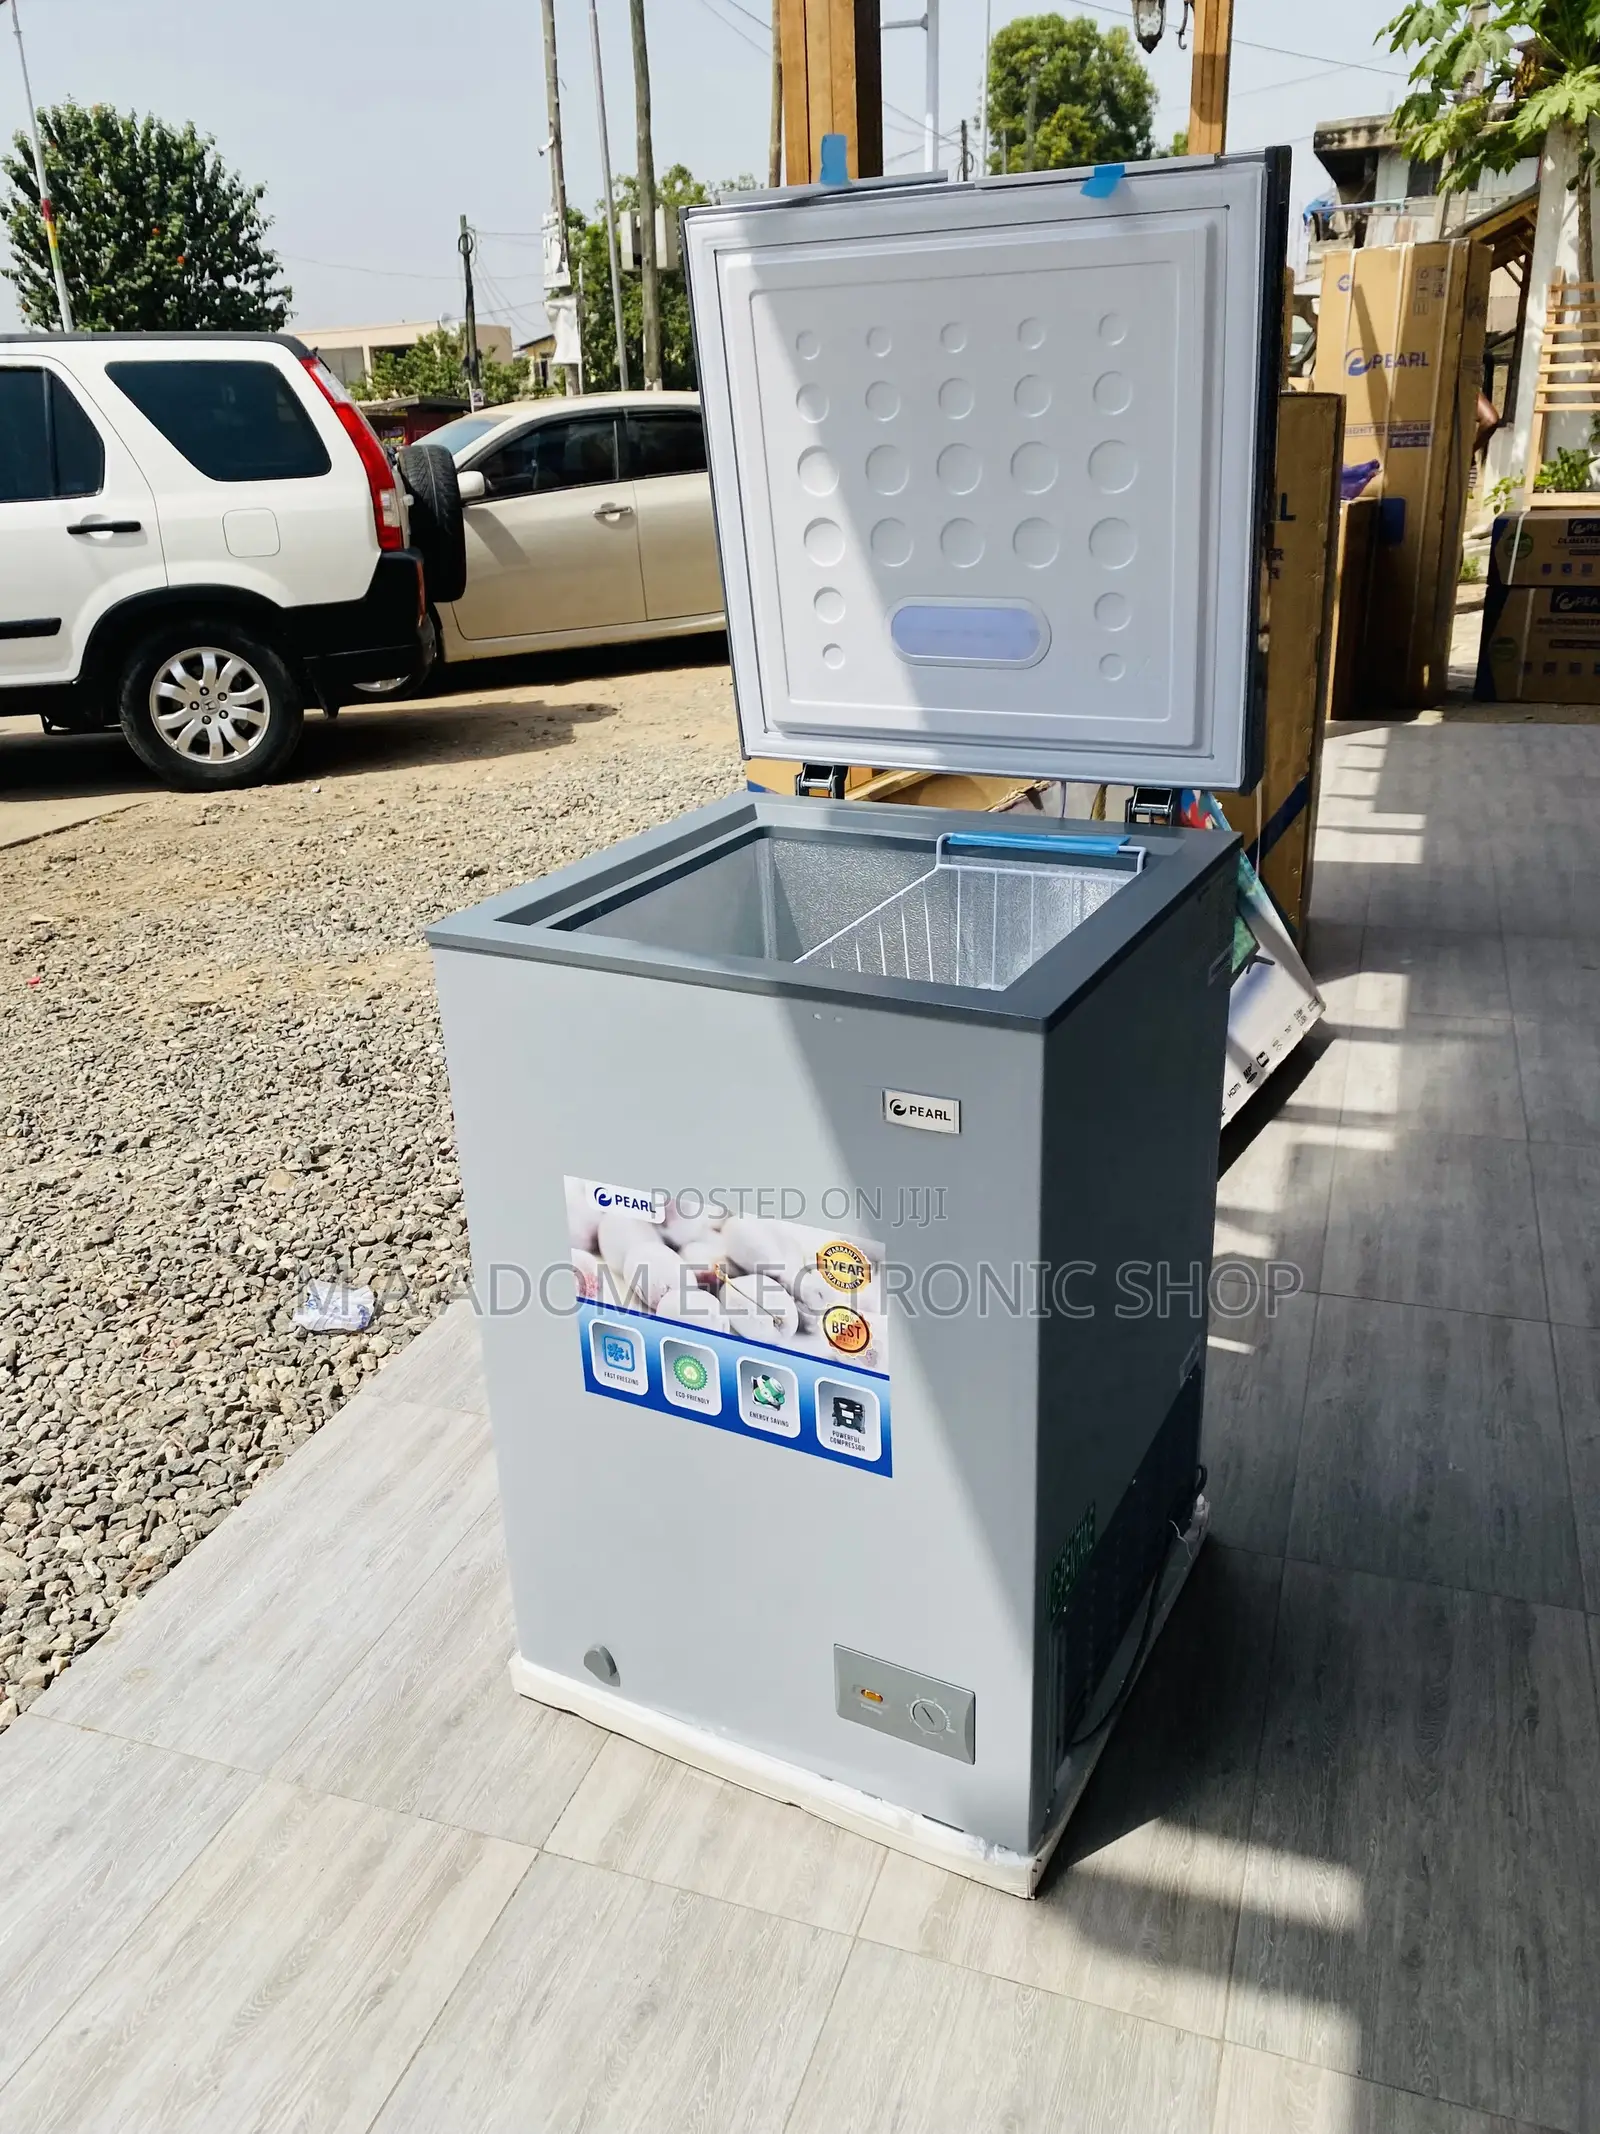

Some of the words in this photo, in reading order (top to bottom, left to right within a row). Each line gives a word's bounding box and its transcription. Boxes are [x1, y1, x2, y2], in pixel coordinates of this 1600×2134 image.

[1372, 352, 1430, 369] PEARL
[1227, 1082, 1242, 1099] HDMI
[909, 1104, 952, 1121] PEARL
[615, 1193, 657, 1214] PEARL
[826, 1246, 863, 1264] WARRANTY
[830, 1259, 866, 1278] YEAR
[831, 1320, 863, 1341] BEST
[604, 1371, 616, 1380] FAST
[616, 1374, 640, 1386] FREEZING
[675, 1390, 686, 1399] ECO
[686, 1393, 710, 1405] FRIENDLY
[749, 1411, 769, 1424] ENERGY
[770, 1415, 790, 1428] SAVING
[829, 1436, 866, 1452] COMPRESSOR
[832, 1430, 861, 1444] POWERFUL
